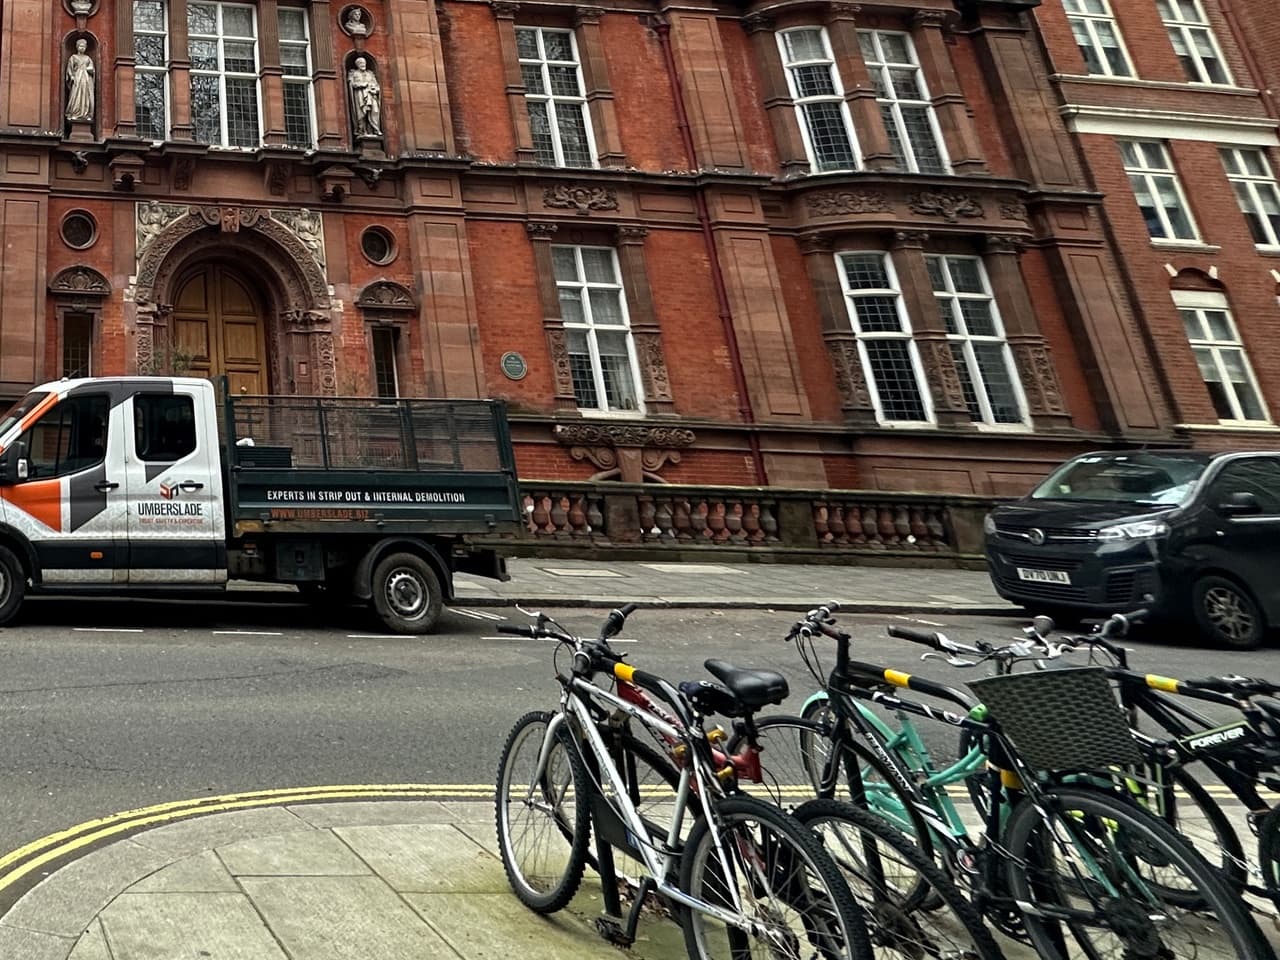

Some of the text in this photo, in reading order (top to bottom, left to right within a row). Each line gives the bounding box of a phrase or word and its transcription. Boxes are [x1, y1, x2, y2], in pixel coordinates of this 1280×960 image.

[267, 490, 466, 503] EXPERTS IN STRIP OUT & INTERNAL DEMOLITION
[137, 503, 203, 516] UMBERSLADE
[1189, 727, 1246, 750] FOREVER
